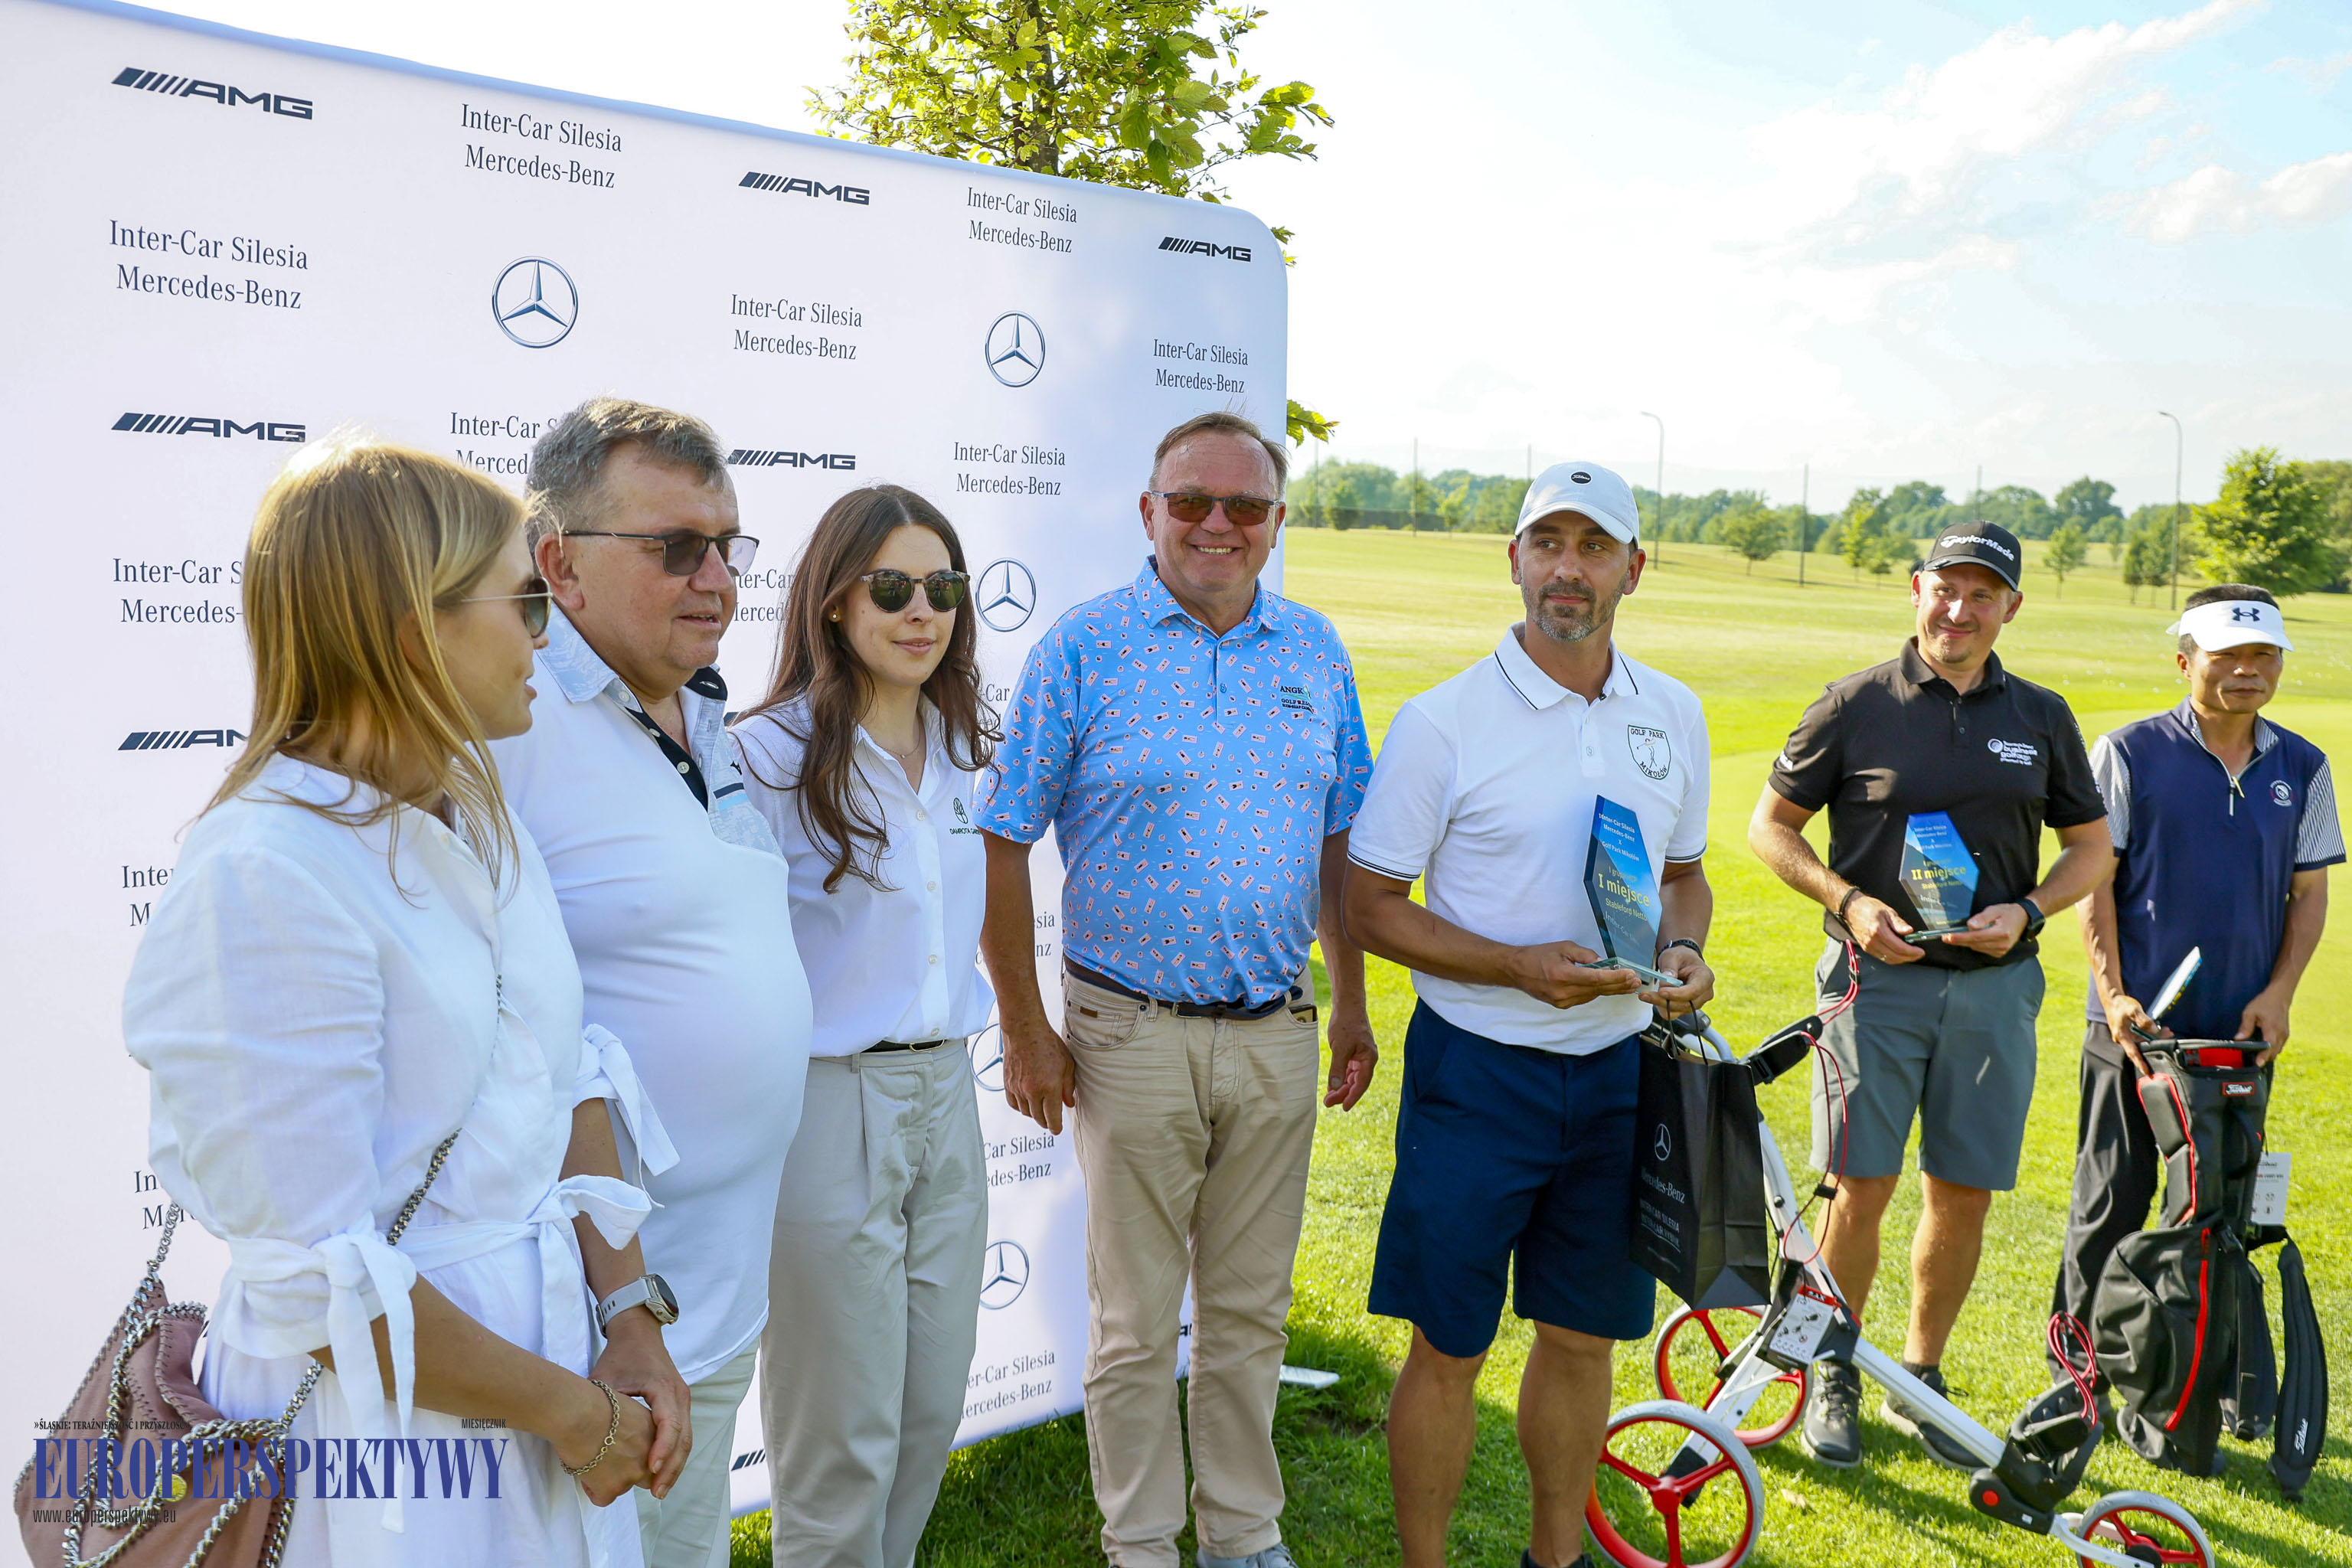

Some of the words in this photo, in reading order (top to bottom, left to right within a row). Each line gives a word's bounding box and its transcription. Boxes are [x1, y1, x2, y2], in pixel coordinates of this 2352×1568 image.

[462, 103, 553, 140] Inter-Car
[560, 121, 621, 152] Silesia
[465, 144, 615, 188] Mercedes-Benz
[968, 187, 1030, 215] Inter-Car
[1034, 198, 1076, 223] Silesia
[109, 220, 223, 258] Inter-Car
[232, 237, 308, 270] Silesia
[969, 220, 1072, 253] Mercedes-Benz
[116, 264, 300, 309] Mercedes-Benz
[731, 294, 805, 321] Inter-Car
[811, 302, 861, 327] Silesia
[733, 329, 856, 360] Mercedes-Benz
[1154, 339, 1207, 361] Inter-Car
[1210, 345, 1248, 365] Silesia
[1155, 368, 1244, 393] Mercedes-Benz
[450, 412, 540, 438] Inter-Car
[954, 442, 1017, 462] Inter-Car
[1021, 446, 1065, 466] Silesia
[956, 473, 1061, 495] Mercedes-Benz
[1940, 535, 2015, 561] TaylorMade
[113, 558, 222, 583] Inter-Car
[121, 599, 242, 622] Mercedes-
[1279, 685, 1304, 694] ANGK
[1648, 730, 1664, 739] PARK
[1640, 761, 1668, 778] MIKOŁÓW
[1603, 823, 1635, 842] Mercedes-Benz
[1911, 869, 1923, 880] II
[1923, 867, 1966, 879] miejsce
[1598, 873, 1604, 888] I
[1606, 879, 1651, 907] miejsce
[1011, 1132, 1055, 1155] Silesia
[1013, 1351, 1054, 1374] Silesia
[962, 1380, 1051, 1419] ercedes-Benz
